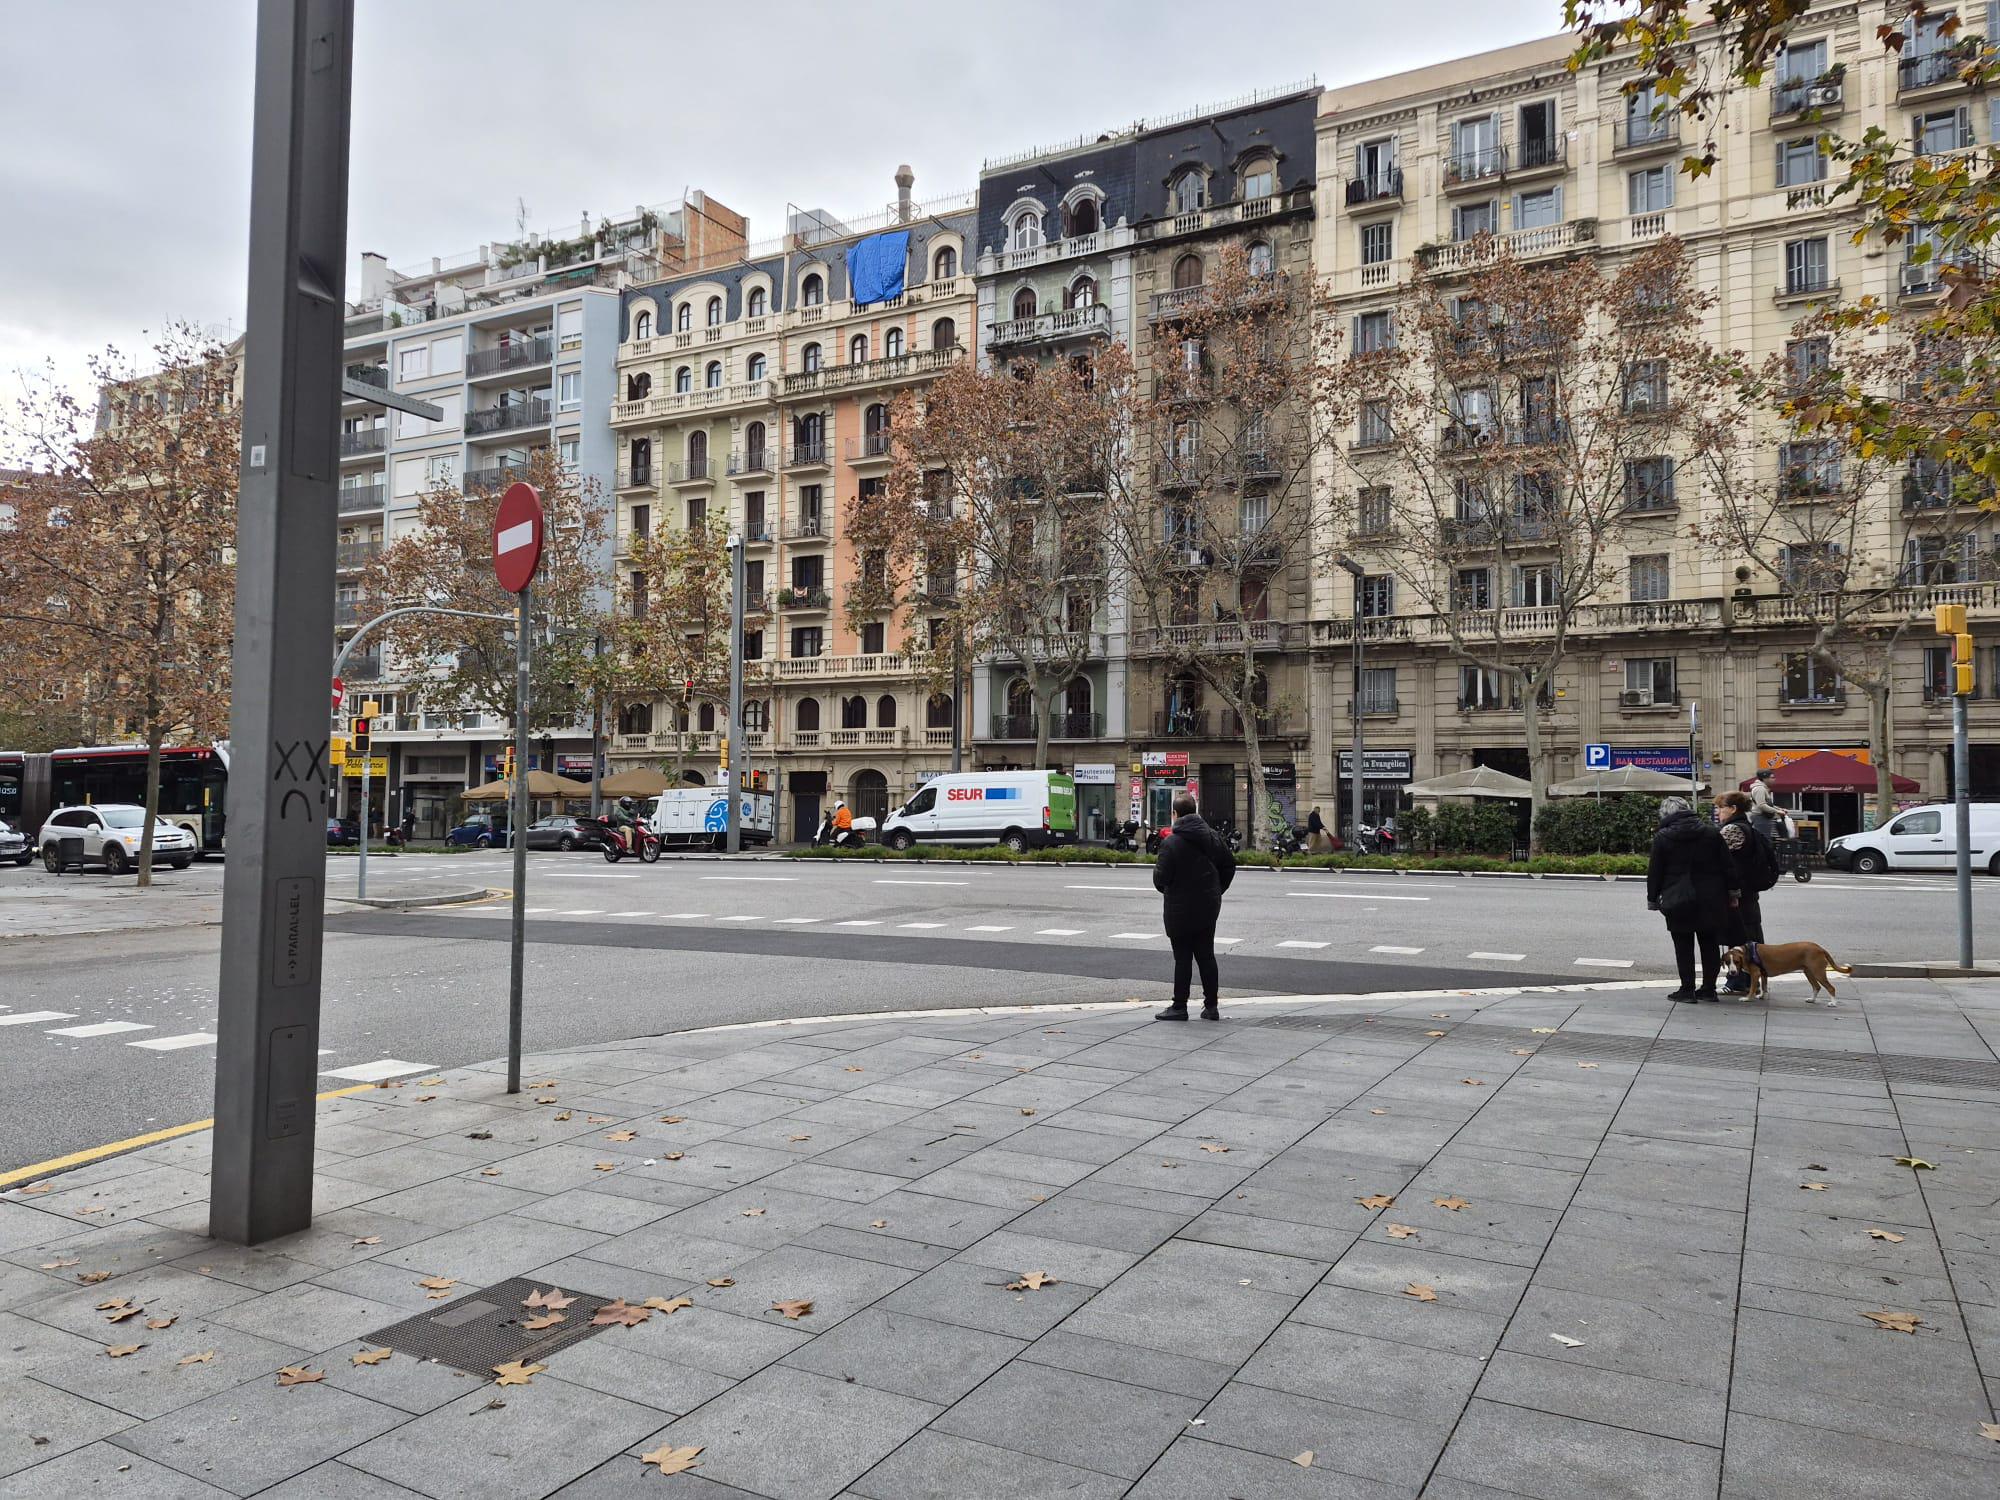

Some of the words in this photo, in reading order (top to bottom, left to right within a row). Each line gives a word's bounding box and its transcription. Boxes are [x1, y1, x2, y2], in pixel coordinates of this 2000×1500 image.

[1590, 747, 1605, 764] P
[1616, 757, 1632, 765] BAR
[1635, 757, 1688, 765] RESTAURANT
[947, 788, 983, 801] SEUR
